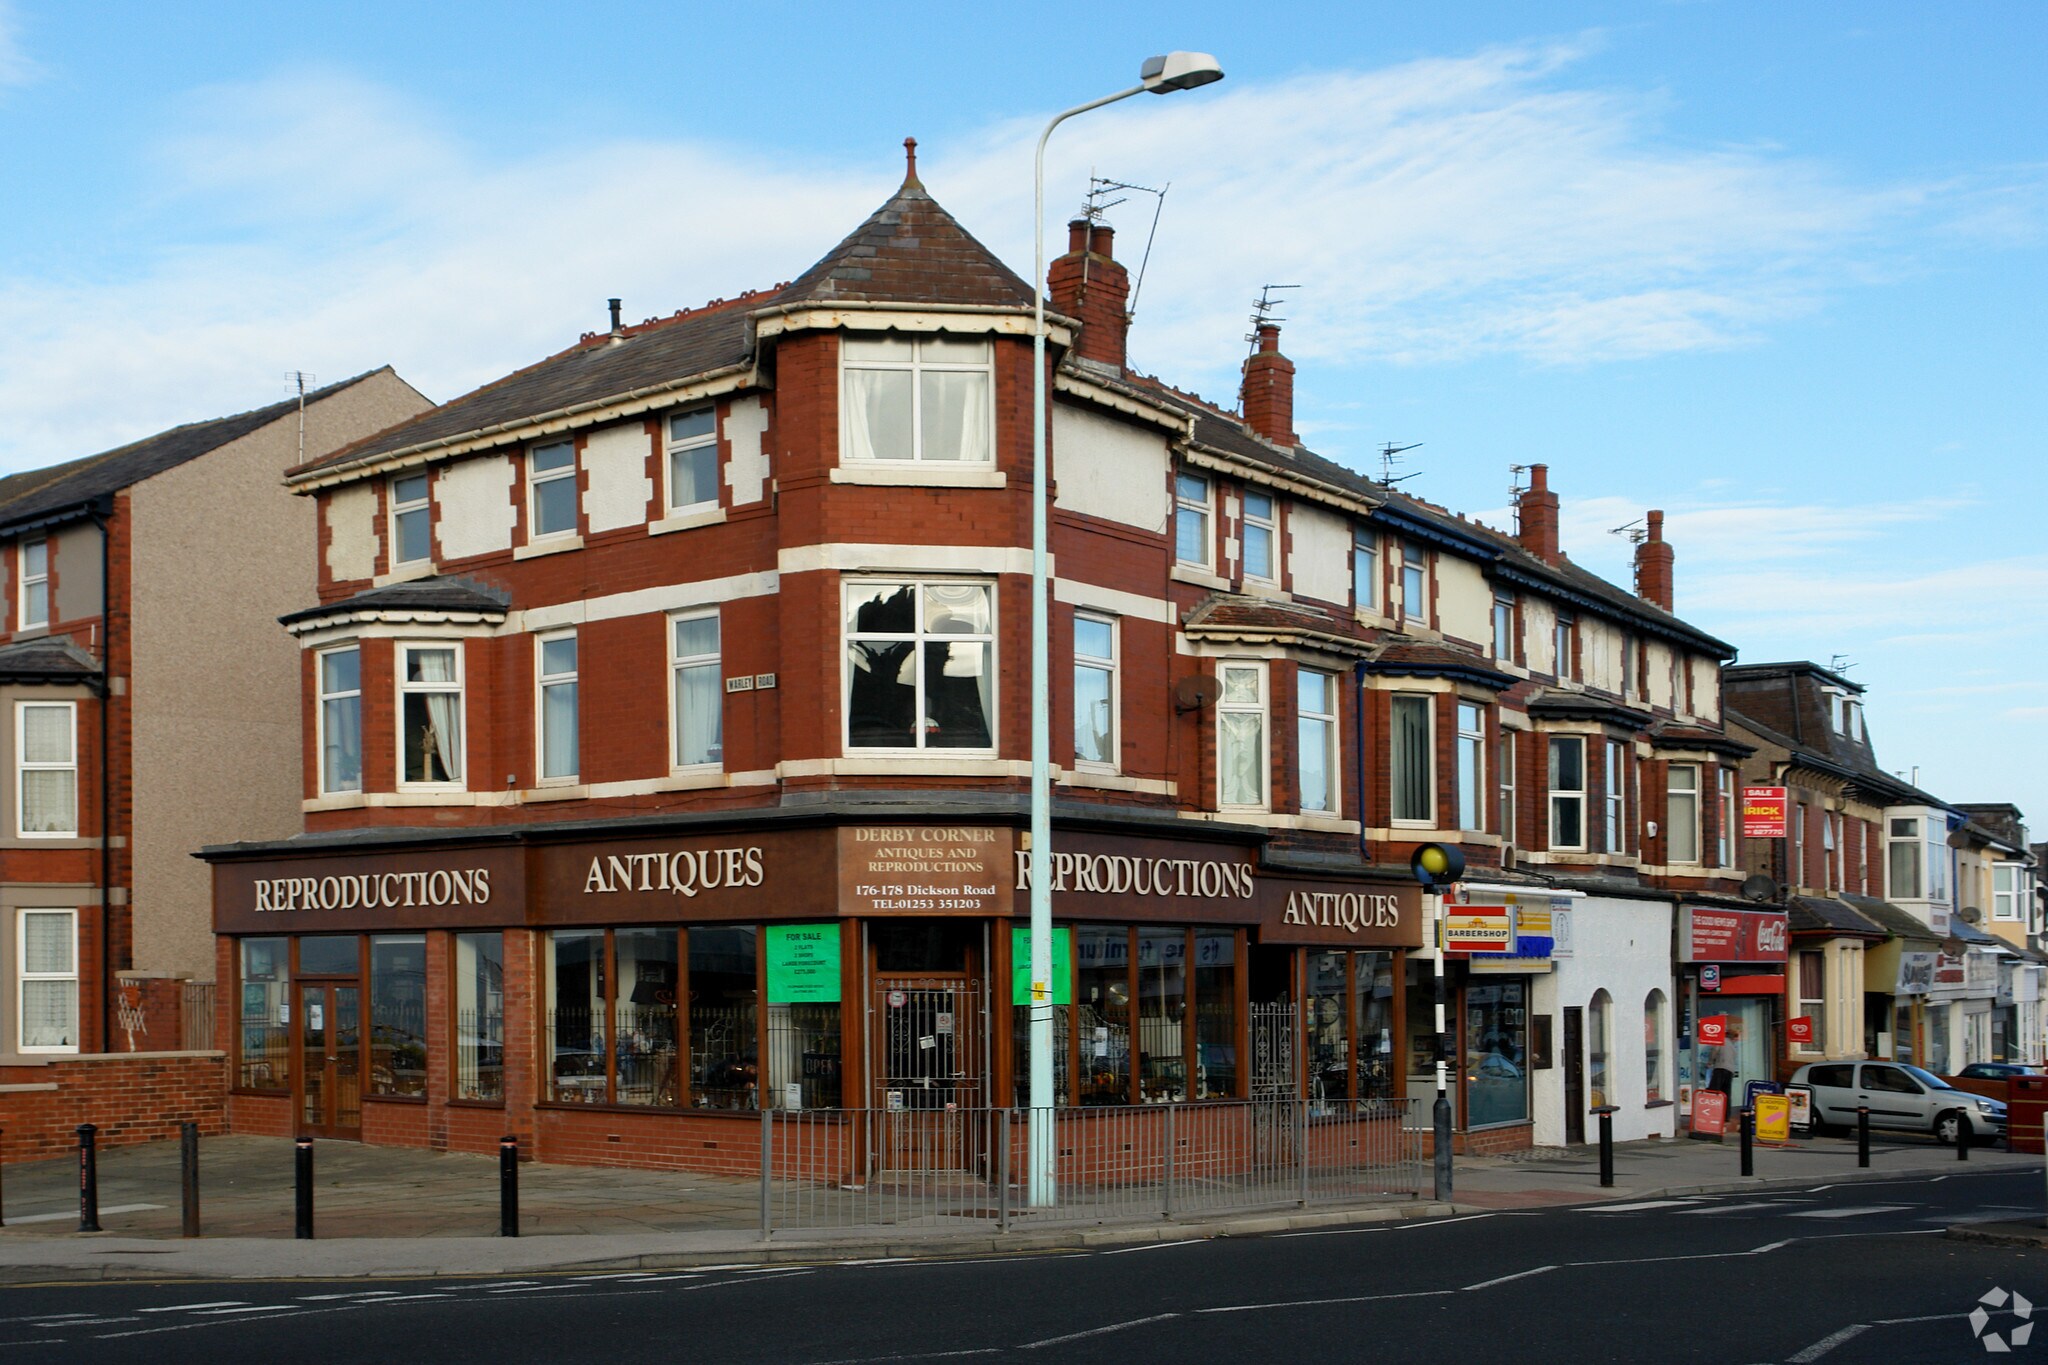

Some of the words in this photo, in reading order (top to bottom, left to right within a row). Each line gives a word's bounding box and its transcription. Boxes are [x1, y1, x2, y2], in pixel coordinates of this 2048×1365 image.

[758, 675, 774, 687] ROAD
[856, 828, 916, 842] DERBY
[921, 828, 996, 842] CORNER
[874, 848, 944, 860] ANTIQUES
[947, 848, 977, 859] AND
[584, 847, 764, 898] ANTIQUES
[868, 862, 984, 872] REPRODUCTIONS
[254, 868, 490, 912] REPRODUCTIONS
[856, 885, 904, 896] 176-178
[907, 884, 960, 896] Dickson
[963, 884, 996, 896] Road
[872, 899, 934, 910] TEL:01253
[938, 899, 982, 910] 351203
[1283, 890, 1399, 933] ANTIQUES
[786, 933, 800, 941] FOR
[1448, 930, 1508, 938] BARBERSHOP
[1699, 1098, 1721, 1106] CASH
